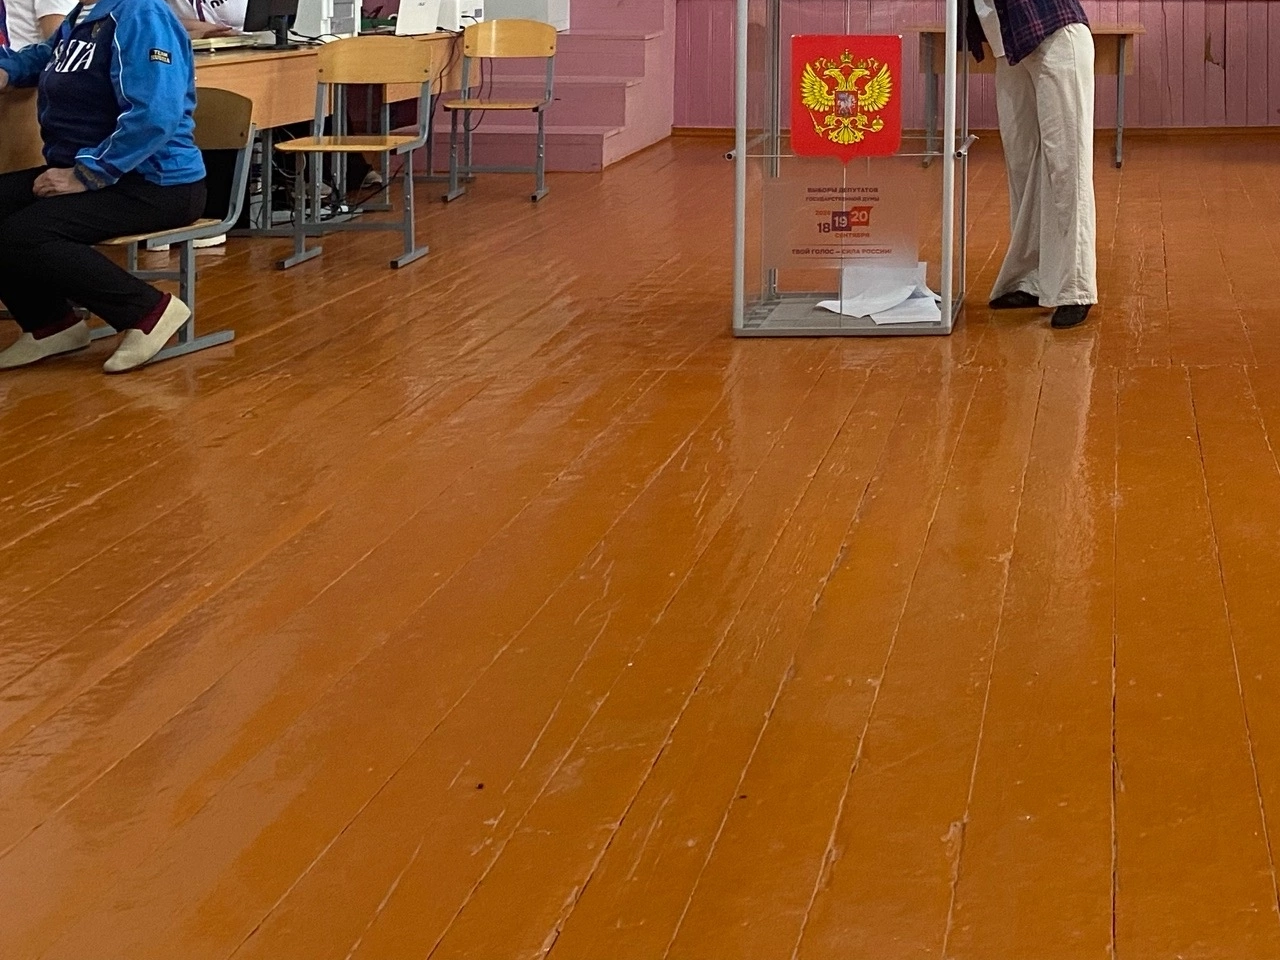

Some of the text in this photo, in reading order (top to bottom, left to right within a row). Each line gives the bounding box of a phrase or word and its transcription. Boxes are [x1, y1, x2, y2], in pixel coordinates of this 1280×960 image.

[817, 210, 869, 233] 18 19 20
